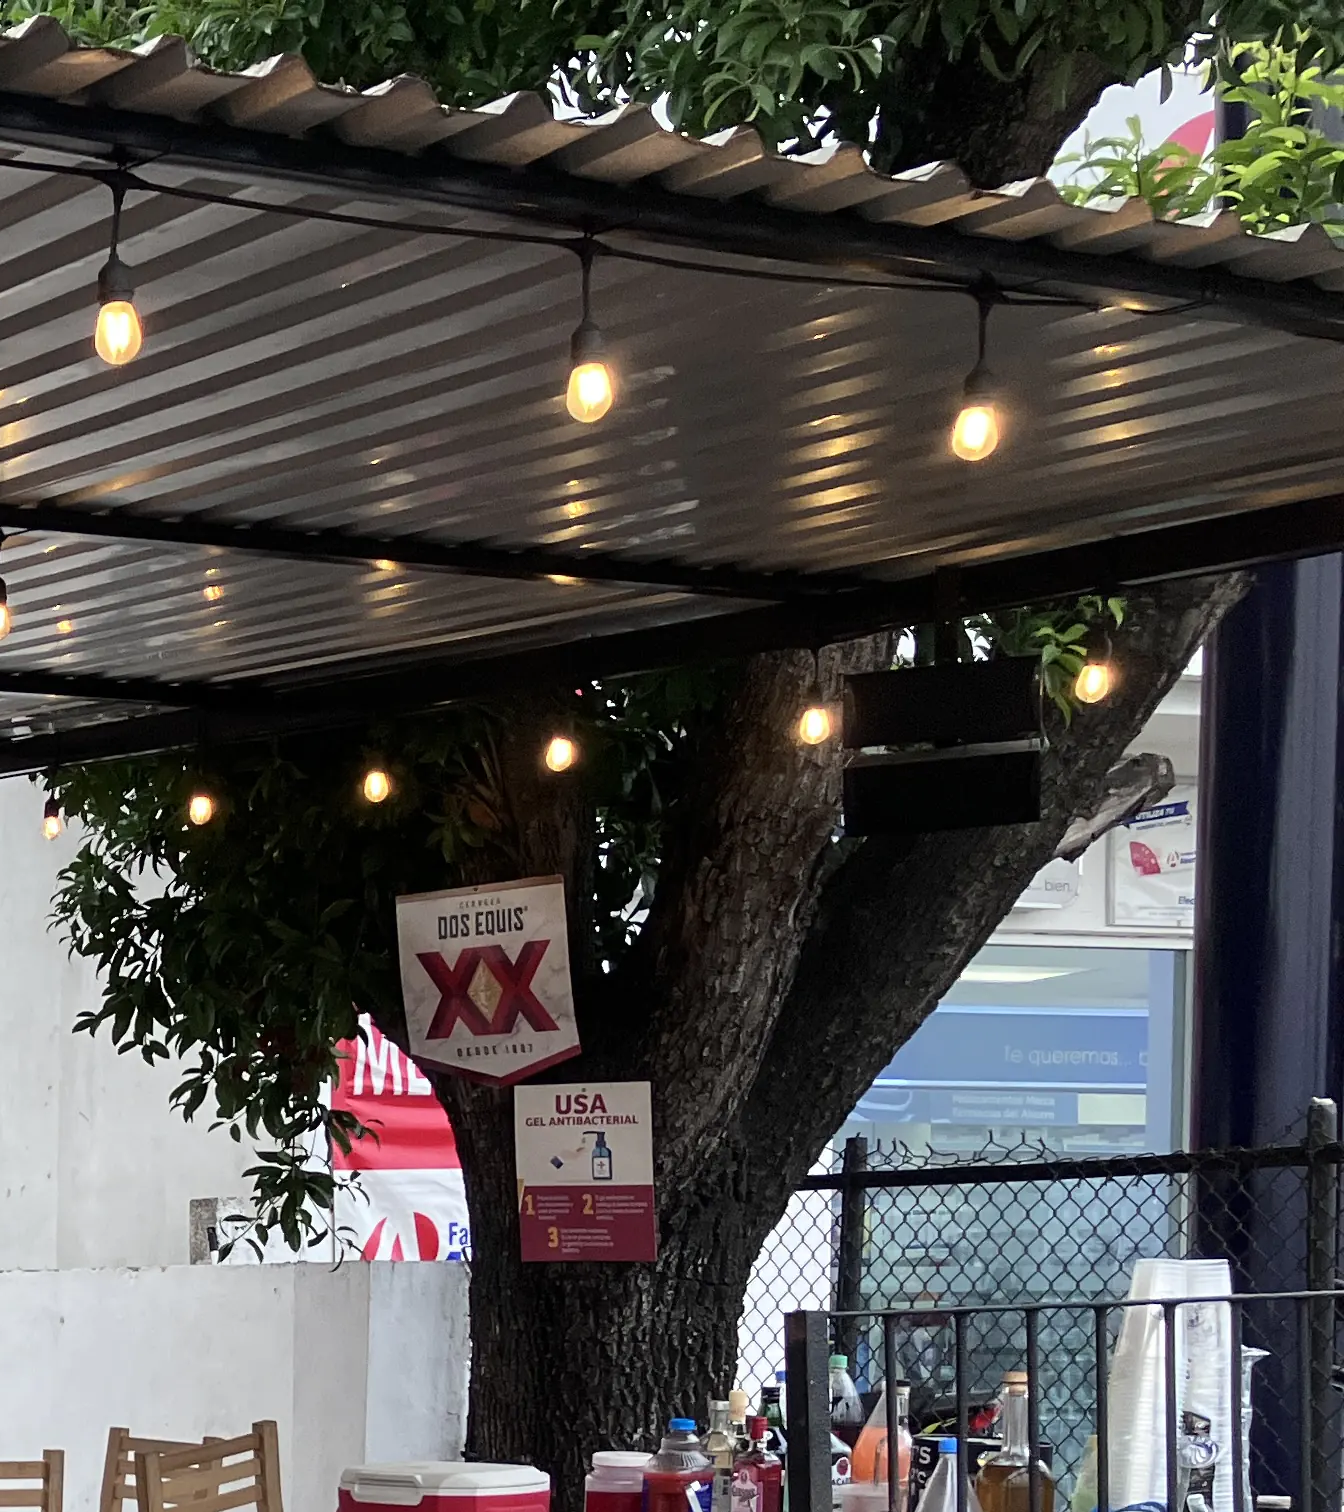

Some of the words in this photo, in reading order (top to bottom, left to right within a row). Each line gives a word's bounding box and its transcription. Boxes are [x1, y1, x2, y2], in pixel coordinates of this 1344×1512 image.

[438, 914, 470, 940] DOS
[475, 907, 523, 937] EQUIS
[414, 939, 560, 1040] XX
[457, 1045, 497, 1057] DESDE
[555, 1093, 608, 1115] USA
[525, 1117, 546, 1127] GEL
[549, 1115, 639, 1126] ANTIBACTERIAL
[525, 1194, 536, 1215] 1
[582, 1193, 594, 1215] 2
[547, 1226, 559, 1248] 3
